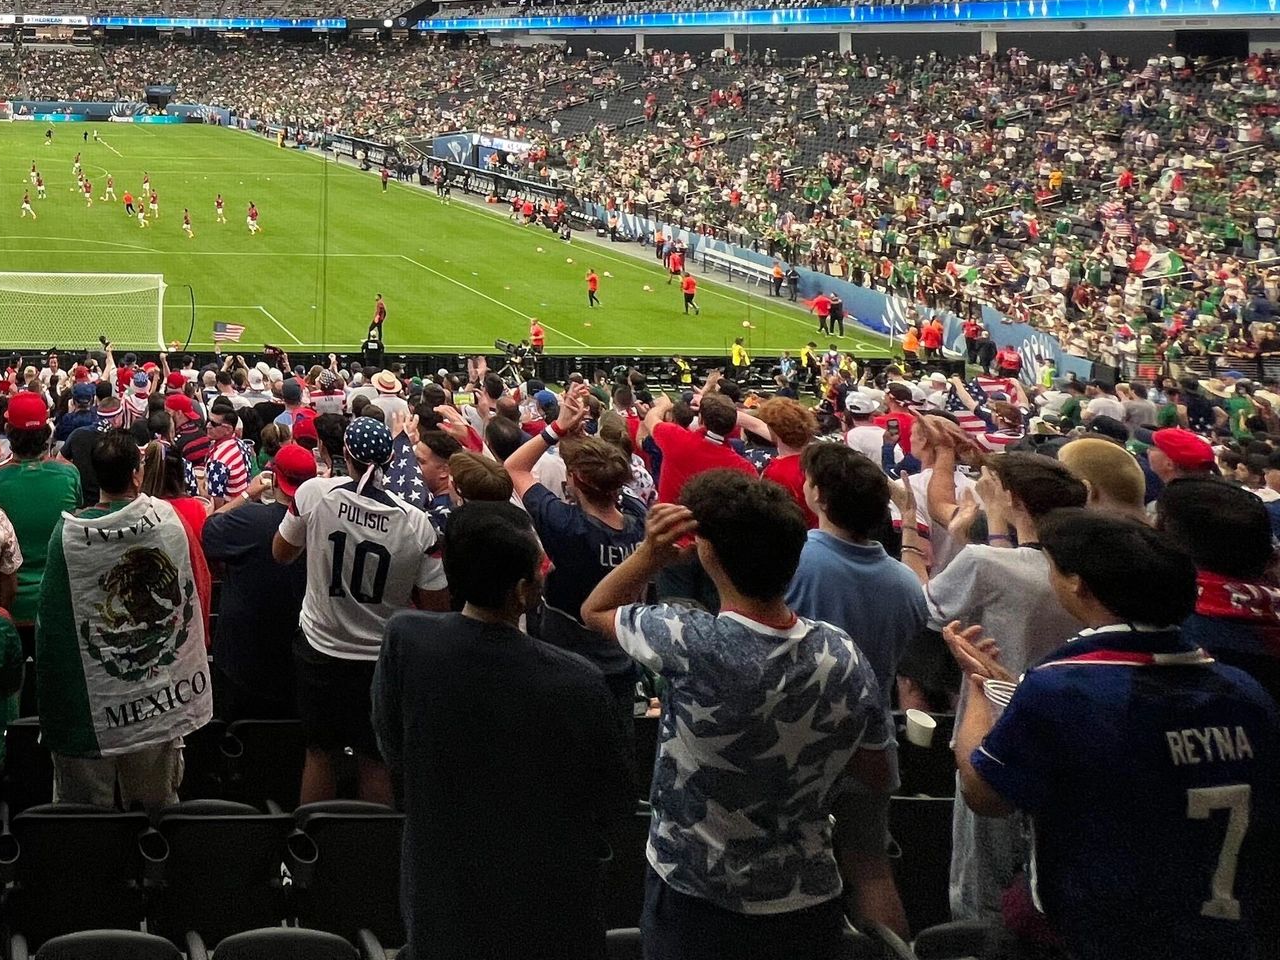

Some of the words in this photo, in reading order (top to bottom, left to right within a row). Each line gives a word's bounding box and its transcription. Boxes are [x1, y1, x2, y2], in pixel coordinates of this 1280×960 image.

[338, 502, 390, 533] PULISIC
[328, 530, 392, 605] 10
[103, 670, 207, 729] MEXICO
[1166, 726, 1254, 766] REYNA
[1187, 784, 1251, 920] 7
